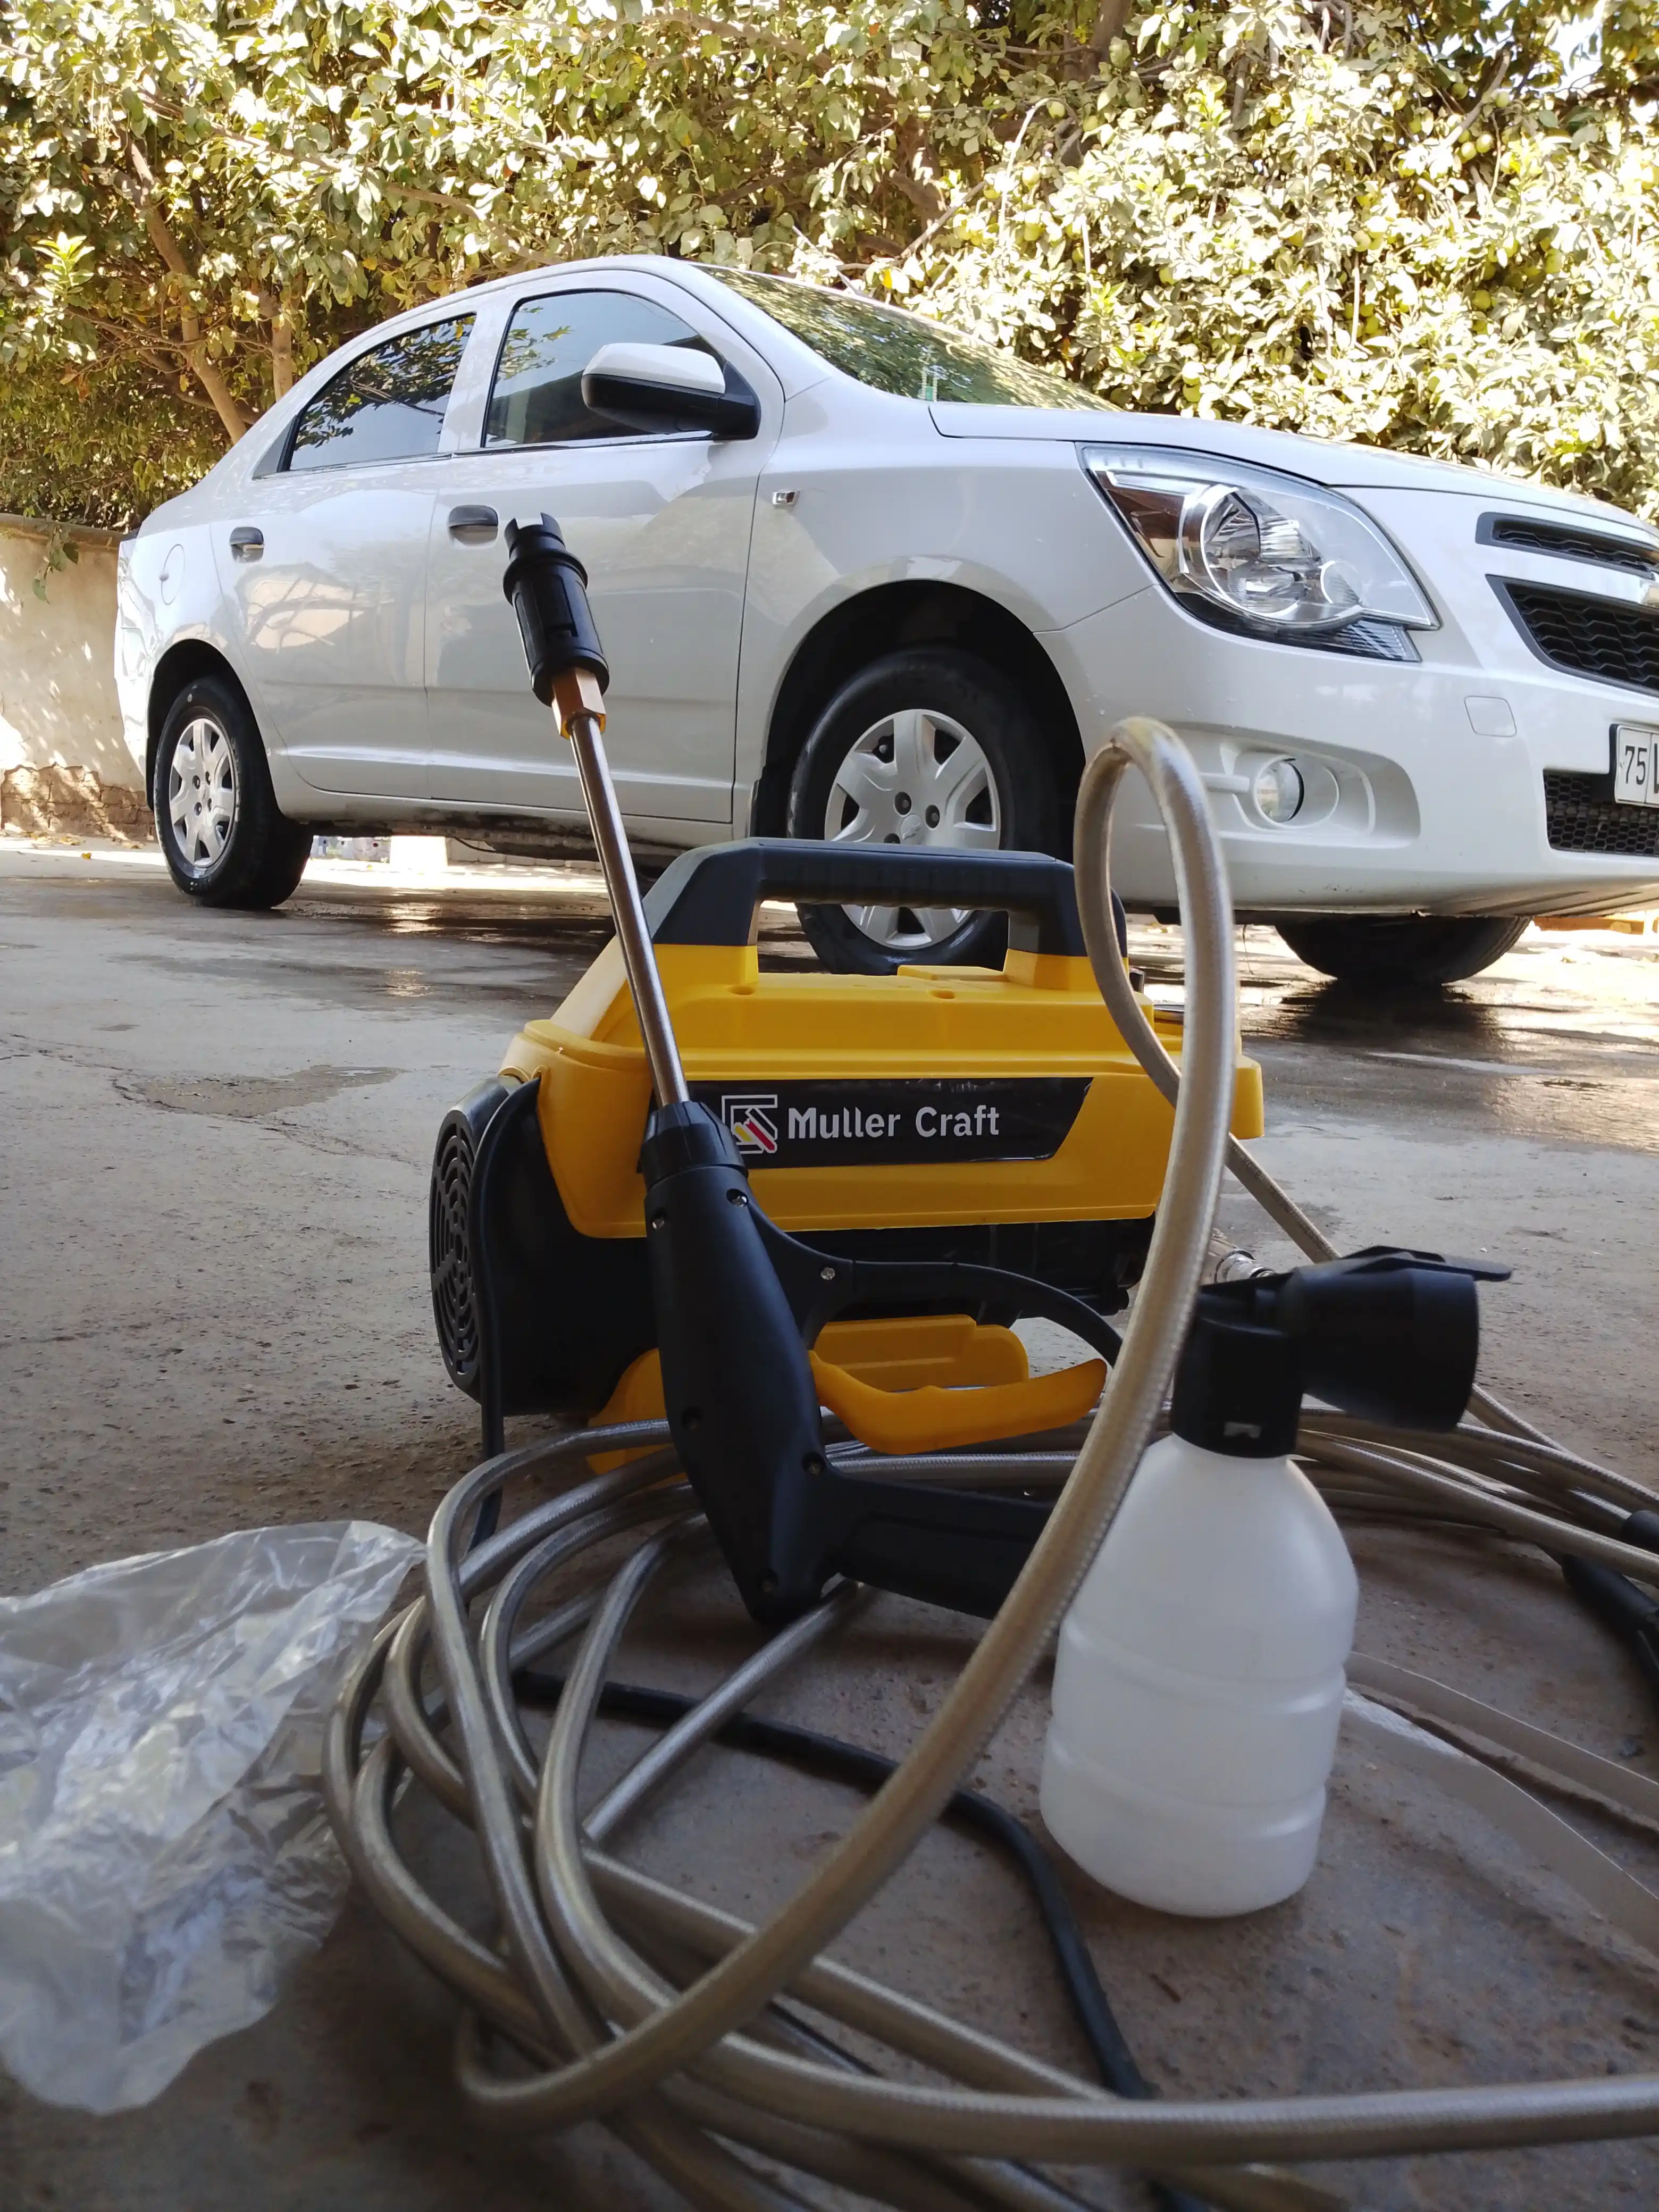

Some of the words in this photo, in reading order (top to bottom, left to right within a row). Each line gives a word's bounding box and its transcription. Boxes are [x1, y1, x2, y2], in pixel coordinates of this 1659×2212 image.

[1625, 745, 1647, 785] 75
[788, 1107, 901, 1139] Muller
[915, 1104, 999, 1137] Craft
